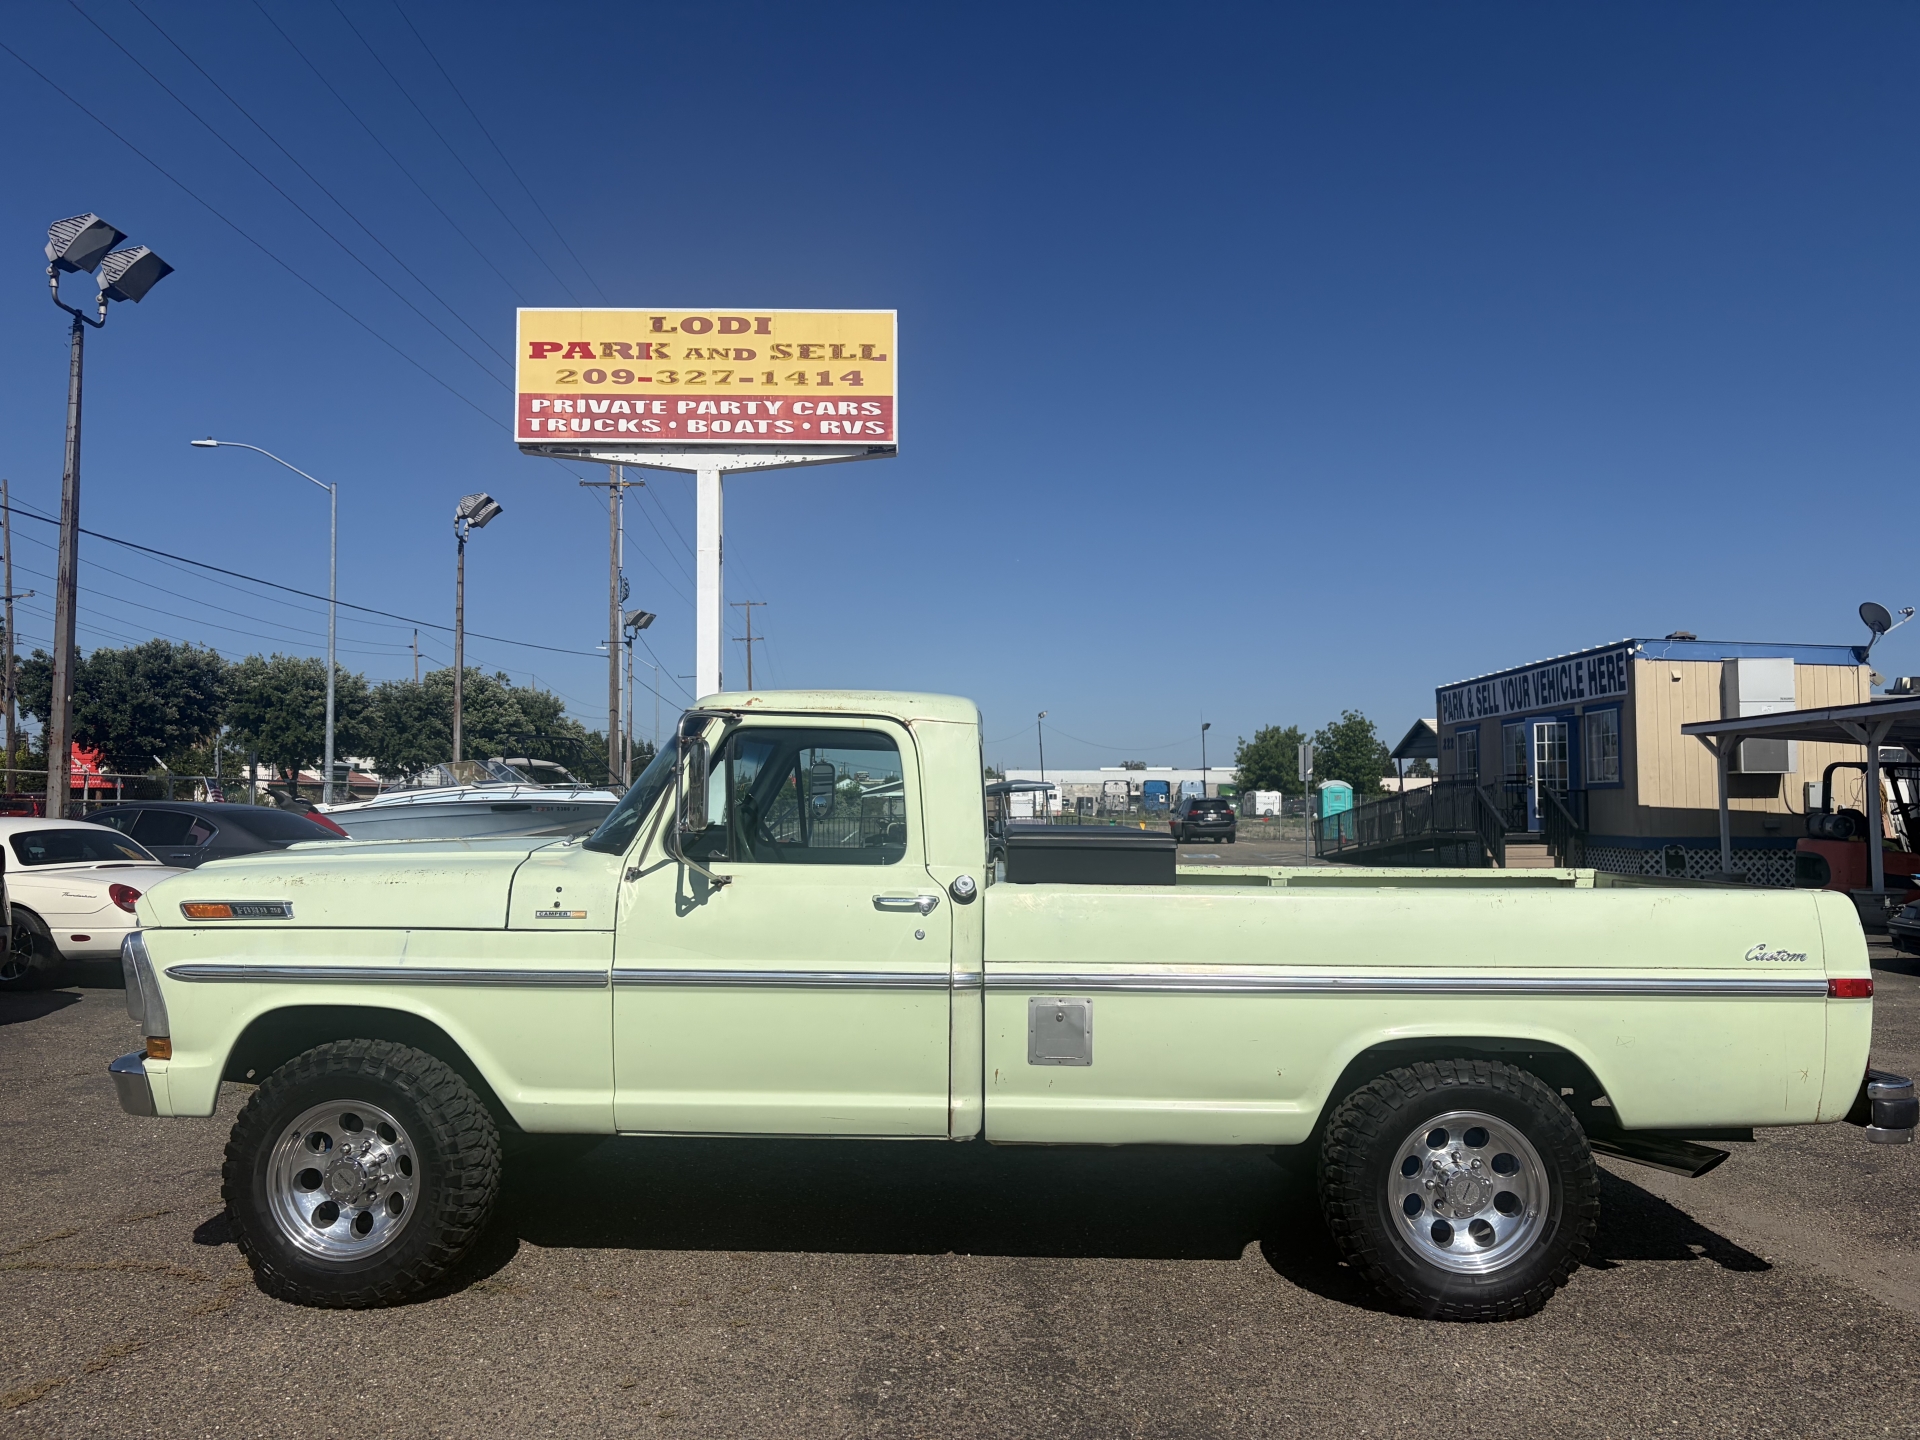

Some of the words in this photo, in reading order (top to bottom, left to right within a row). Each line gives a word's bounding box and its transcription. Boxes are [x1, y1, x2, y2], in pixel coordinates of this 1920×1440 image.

[649, 316, 772, 335] LODI
[529, 341, 671, 360] PARK
[683, 347, 757, 361] AND
[770, 343, 887, 361] SELL
[555, 368, 864, 386] 209-327-1414
[531, 399, 668, 415] PRIVATE
[677, 400, 784, 415] PARTY
[792, 401, 882, 416] CARS
[526, 417, 662, 433] TRUCKS
[687, 419, 795, 434] BOATS
[819, 420, 886, 435] RVS
[1442, 689, 1466, 723] PARK
[1467, 687, 1475, 719] &
[1475, 682, 1500, 718] SELL
[1501, 674, 1531, 712] YOUR
[1533, 664, 1585, 705] VEHICLE
[1588, 652, 1626, 695] HERE
[1745, 943, 1808, 962] Custom
